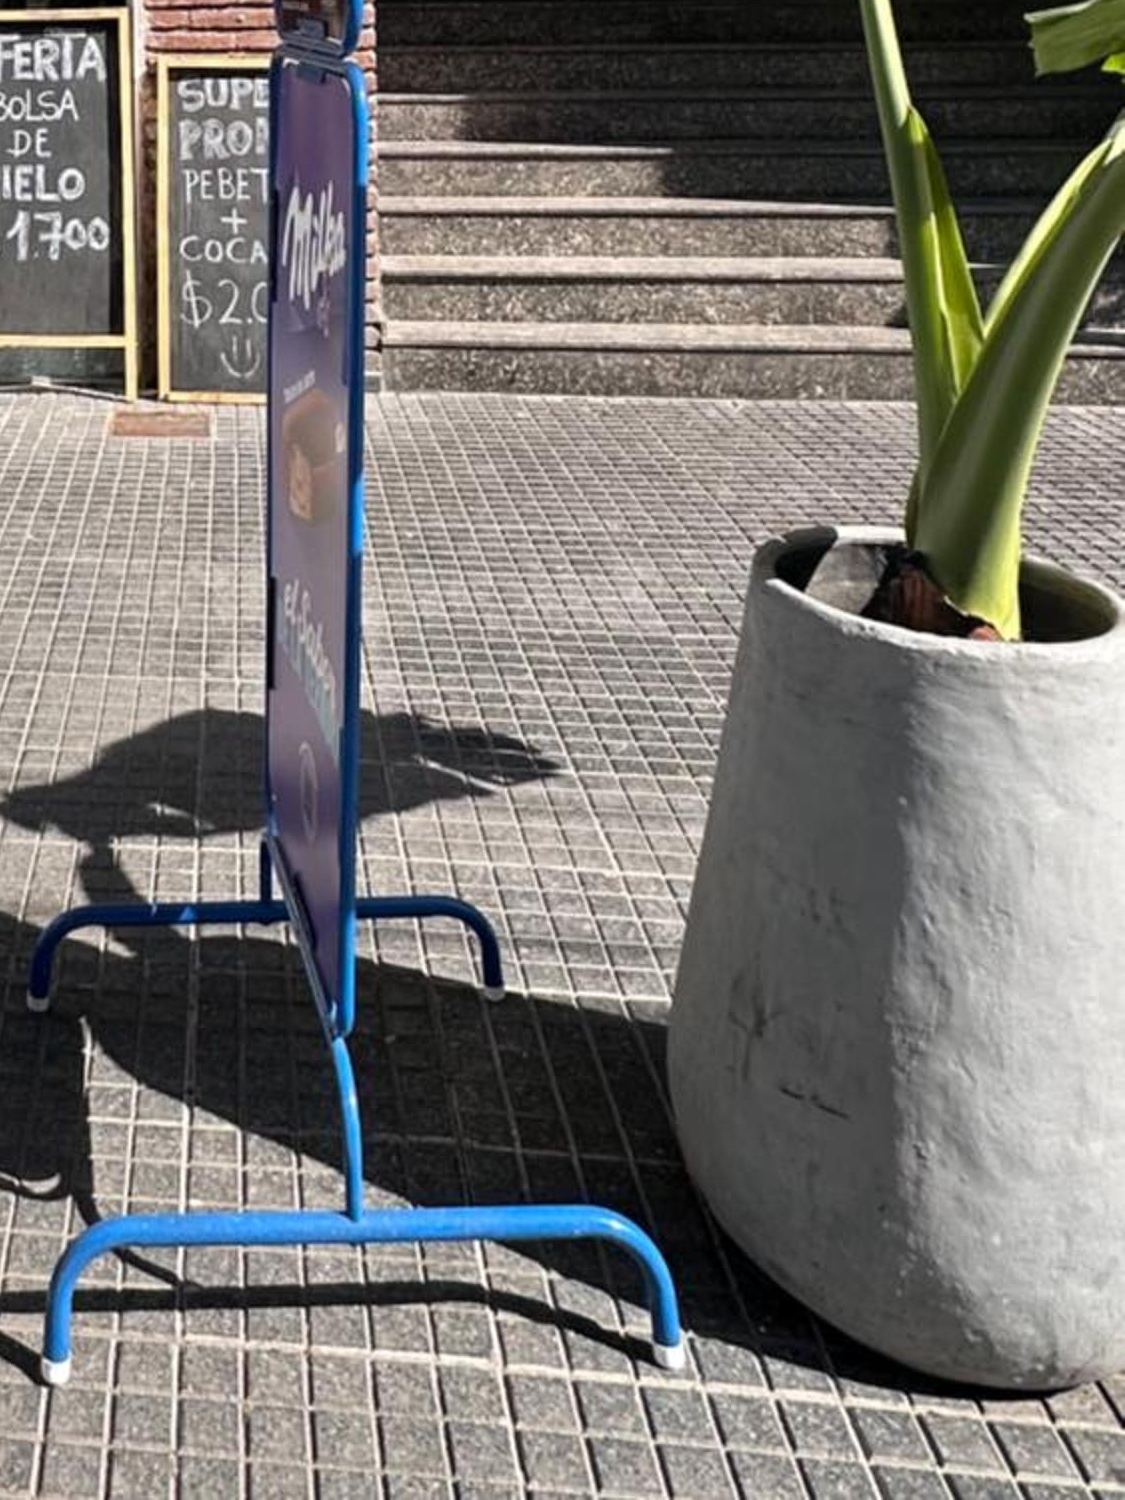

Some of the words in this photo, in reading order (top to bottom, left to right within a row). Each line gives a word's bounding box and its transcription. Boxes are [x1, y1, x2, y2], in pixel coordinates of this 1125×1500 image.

[6, 128, 52, 157] DE
[179, 116, 269, 161] PRO
[180, 235, 268, 264] COCA
[282, 180, 345, 311] Milka
